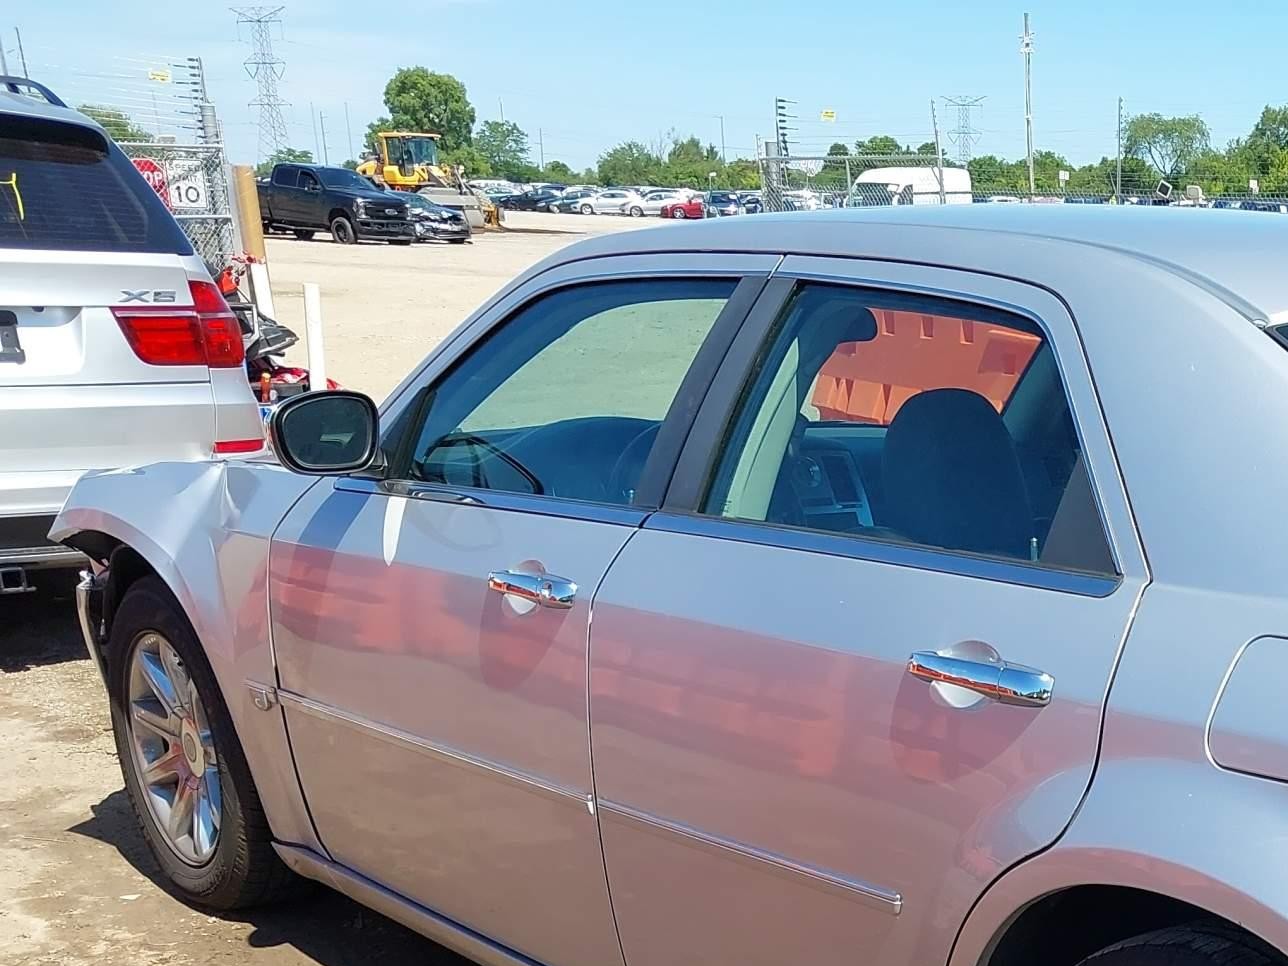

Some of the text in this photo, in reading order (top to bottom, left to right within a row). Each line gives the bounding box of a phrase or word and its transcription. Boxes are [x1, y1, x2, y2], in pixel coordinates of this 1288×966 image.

[142, 171, 163, 186] OP
[175, 186, 200, 203] 10
[118, 290, 177, 303] X5
